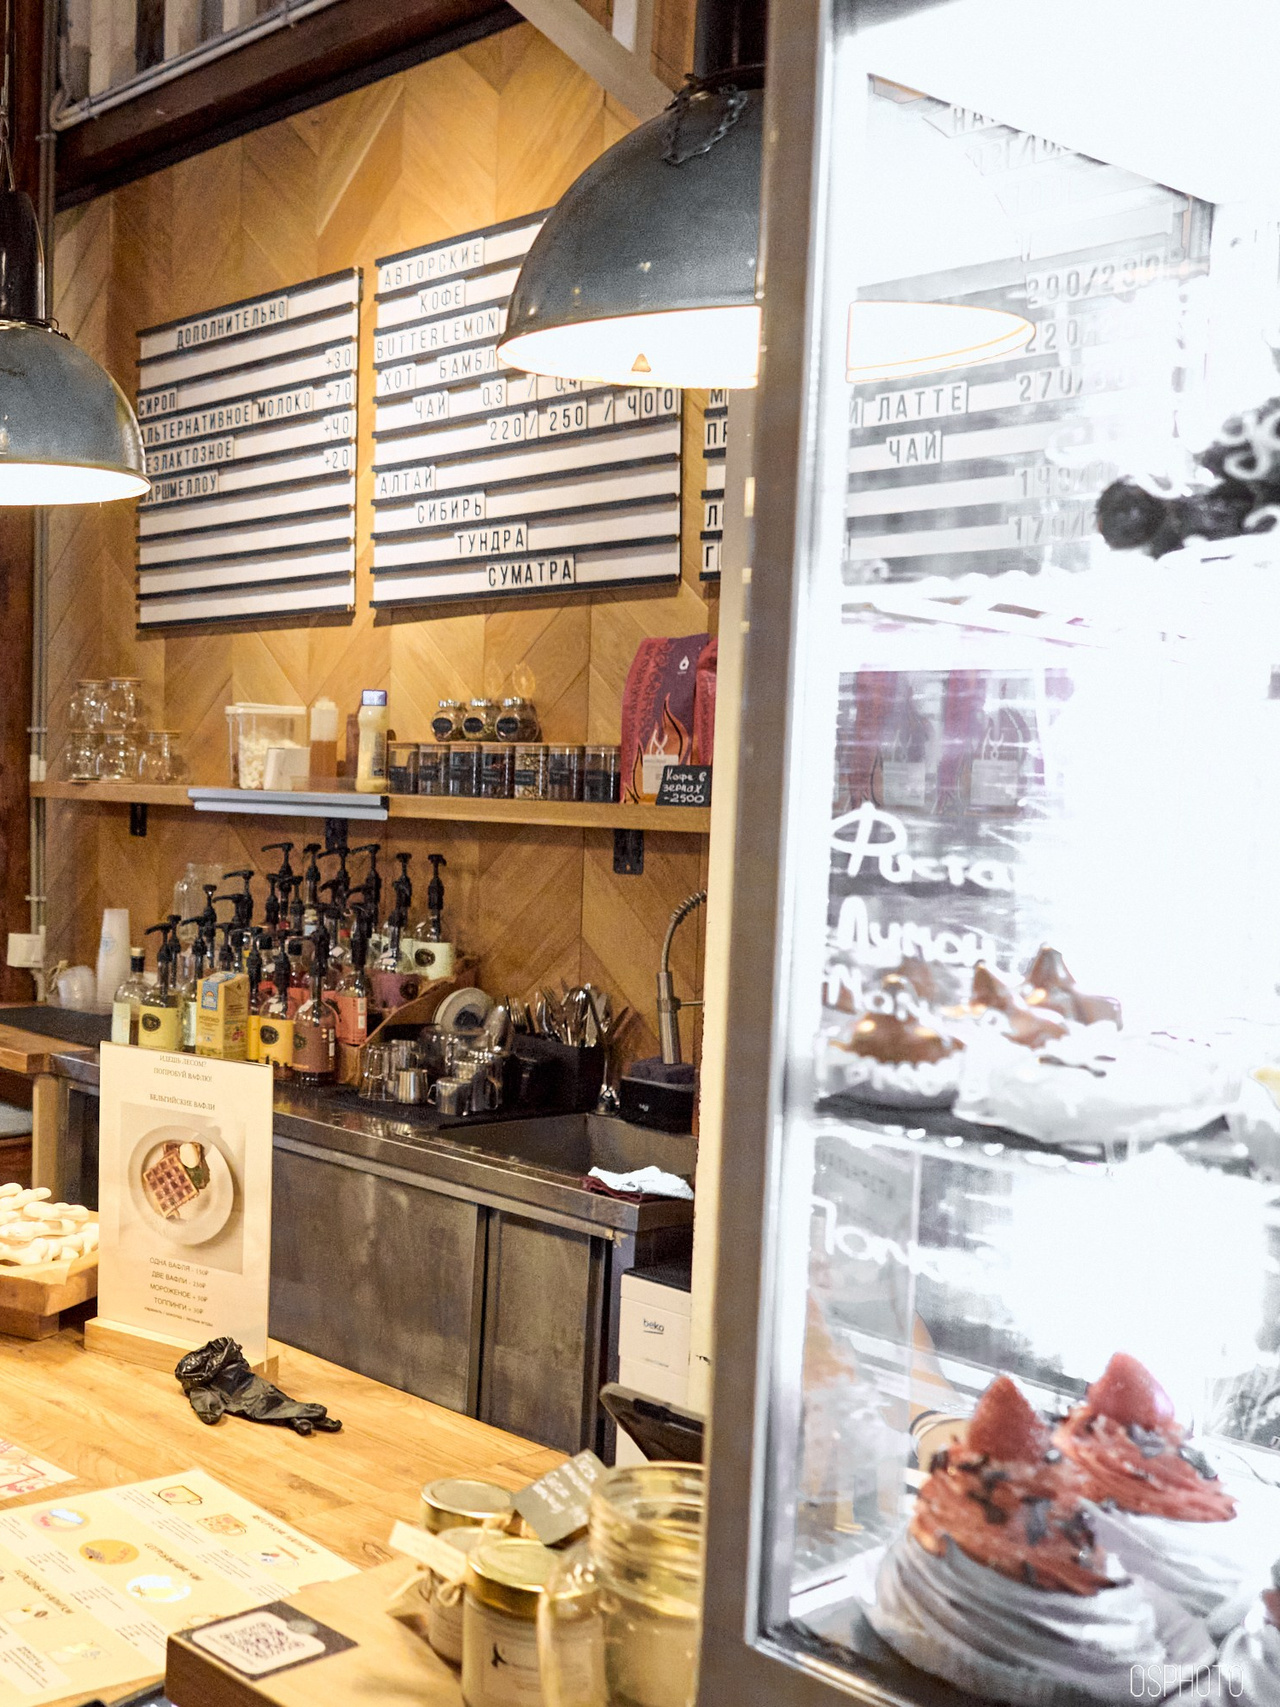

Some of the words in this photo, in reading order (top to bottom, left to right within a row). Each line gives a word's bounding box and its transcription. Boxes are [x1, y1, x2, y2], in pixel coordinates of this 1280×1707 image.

[384, 243, 482, 288] АВТОРСКИЕ
[420, 284, 462, 314] КОФЕ
[176, 300, 286, 350] ДОПОЛНИТЕЛЬНО
[376, 311, 495, 360] BUTTERLEMON
[138, 391, 176, 416] СИРОП
[325, 347, 351, 369] +30
[383, 369, 413, 391] ХОТ
[439, 349, 496, 380] БАМБЛ
[258, 391, 312, 418] МОЛОКО
[326, 381, 352, 402] +70
[415, 390, 447, 418] ЧАЙ
[549, 405, 585, 432] 250
[628, 388, 674, 415] 400
[876, 384, 963, 423] ЛАТТЕ
[146, 442, 232, 474] ЕЗЛАКТОЗНОЕ
[324, 416, 350, 435] +40
[888, 431, 939, 464] ЧАЙ
[144, 474, 217, 502] АРШМЕЛЛОУ
[324, 449, 350, 470] +20
[380, 465, 433, 495] АЛТАЙ
[417, 496, 482, 524] СИБИРЬ
[457, 527, 525, 556] ТУНДРА
[488, 559, 572, 587] СУМАТРА
